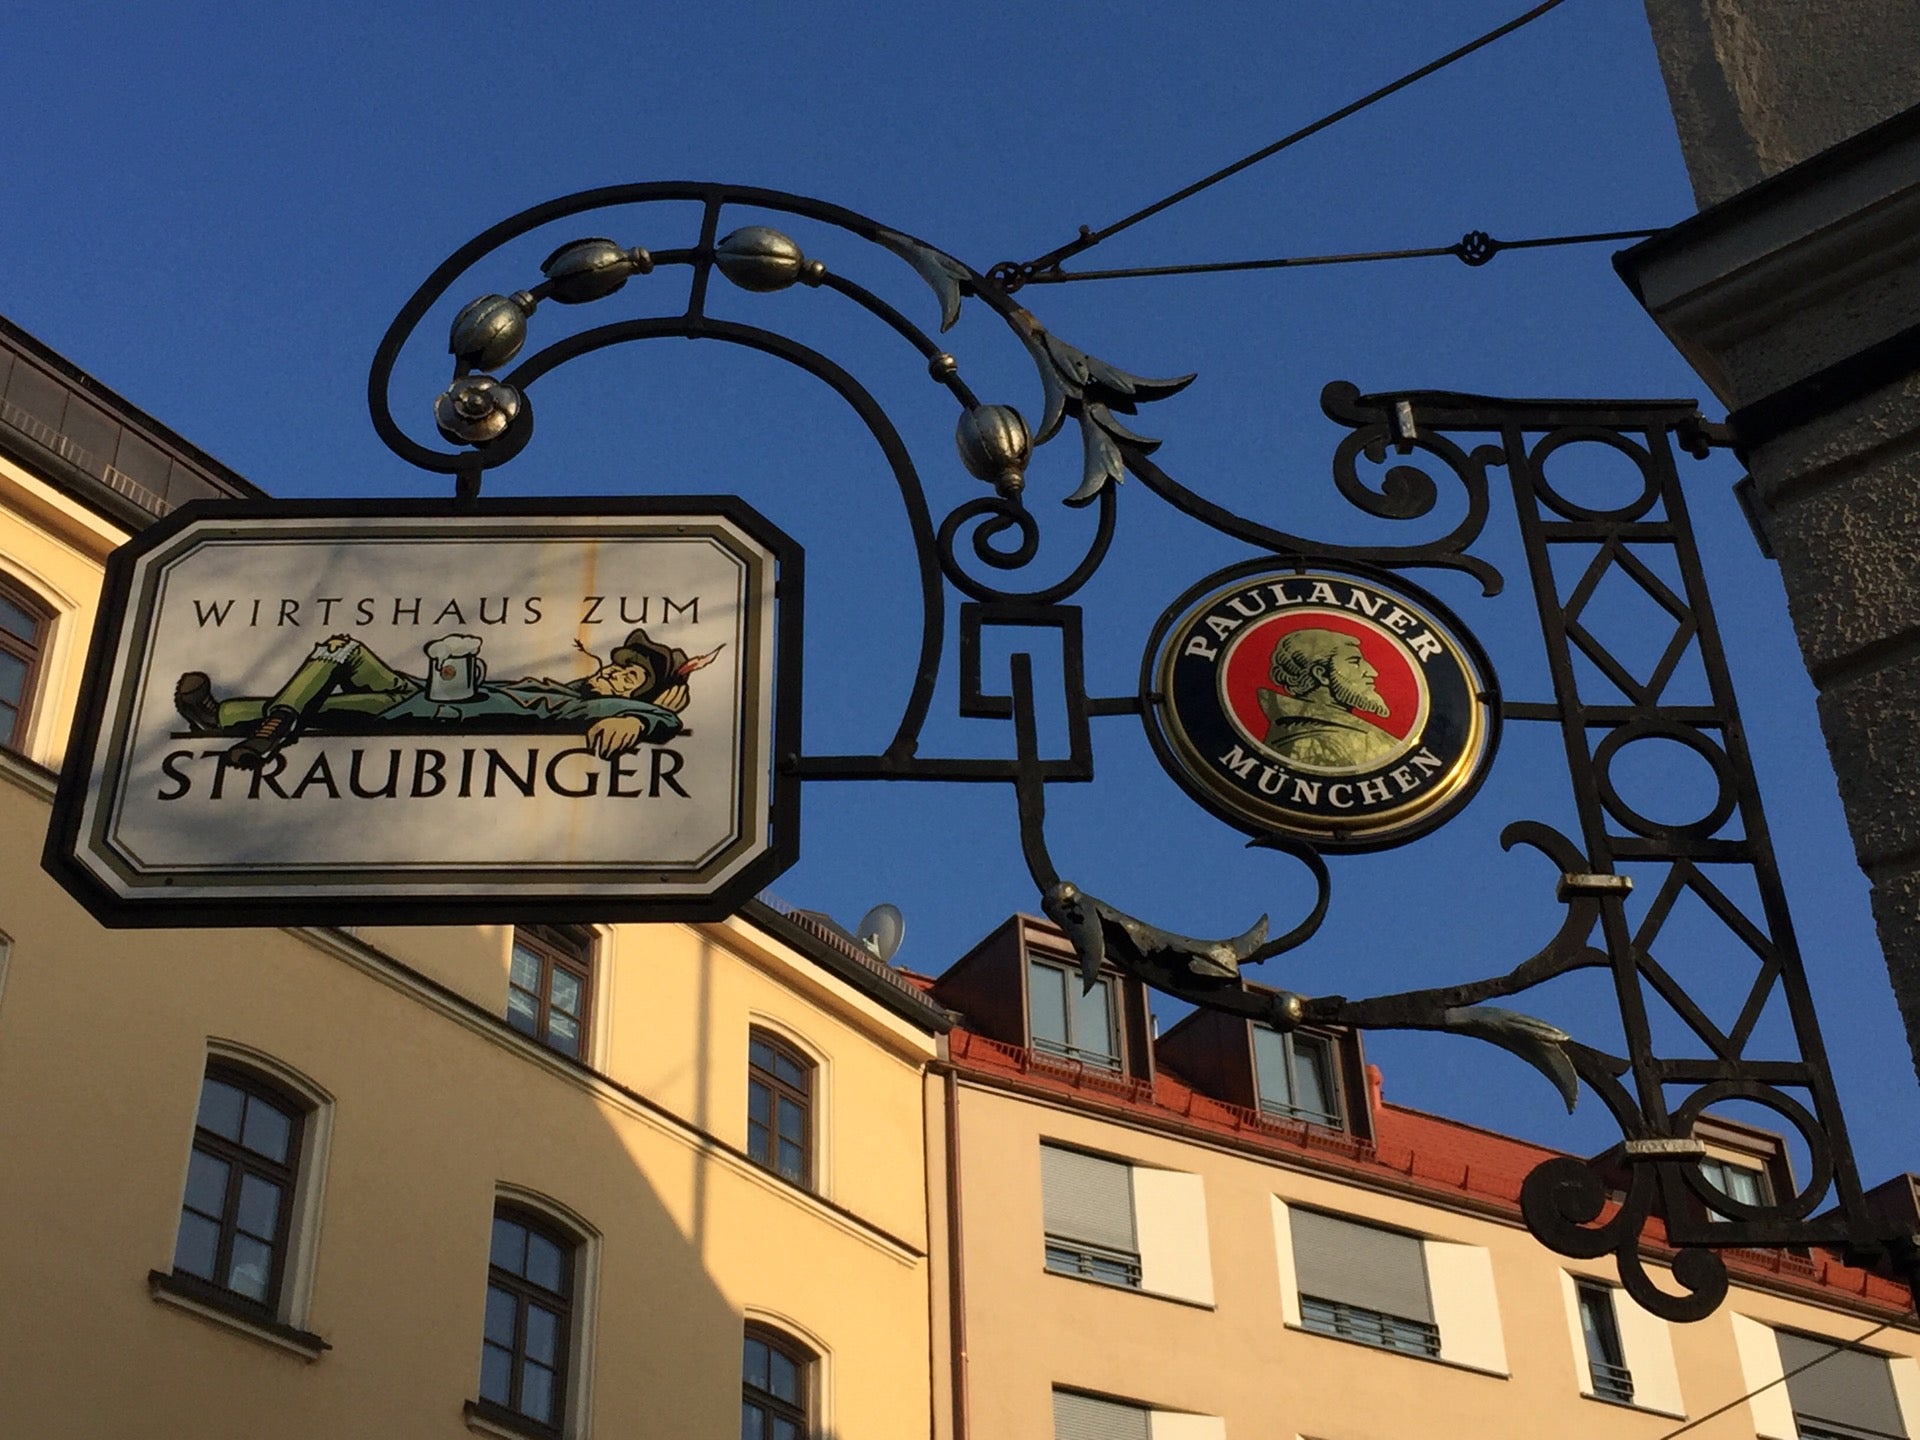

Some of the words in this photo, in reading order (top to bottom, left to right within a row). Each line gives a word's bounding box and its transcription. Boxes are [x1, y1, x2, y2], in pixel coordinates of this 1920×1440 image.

[193, 597, 542, 627] WIRTSHAUS
[580, 596, 699, 625] ZUM
[1185, 581, 1443, 662] PAULANER
[157, 748, 692, 800] STRAUBINGER
[1219, 745, 1443, 808] MÜNCHEN
